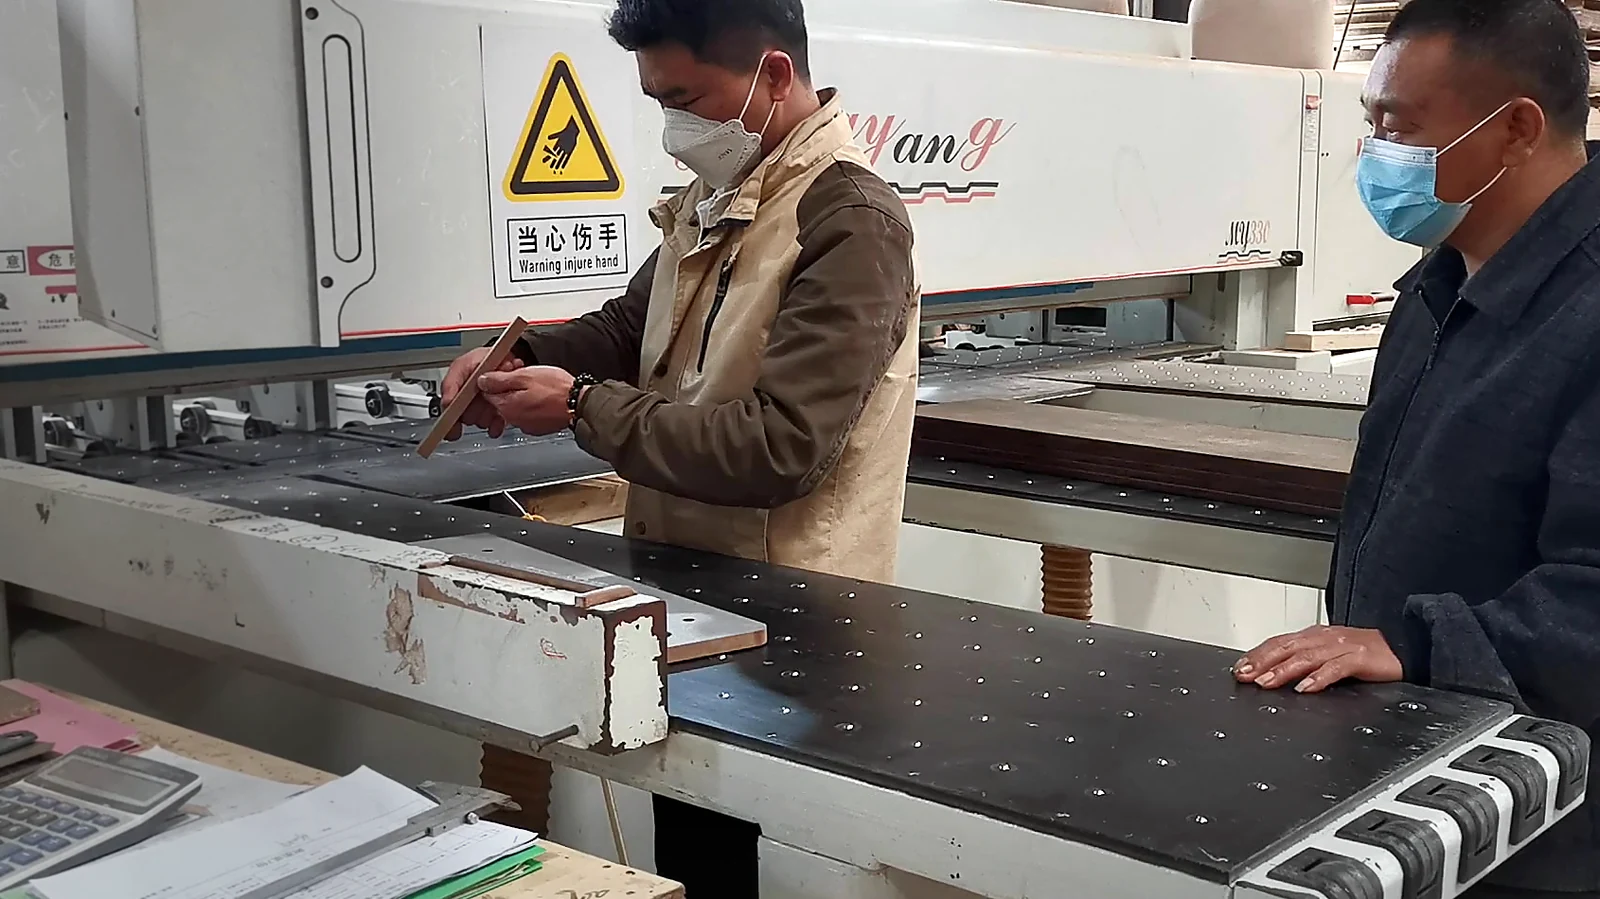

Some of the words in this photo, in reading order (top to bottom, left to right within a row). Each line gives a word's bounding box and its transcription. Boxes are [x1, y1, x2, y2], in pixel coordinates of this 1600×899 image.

[518, 222, 618, 254] 当心伤手
[519, 258, 561, 275] Warning
[564, 256, 593, 273] injure
[595, 254, 619, 269] hand
